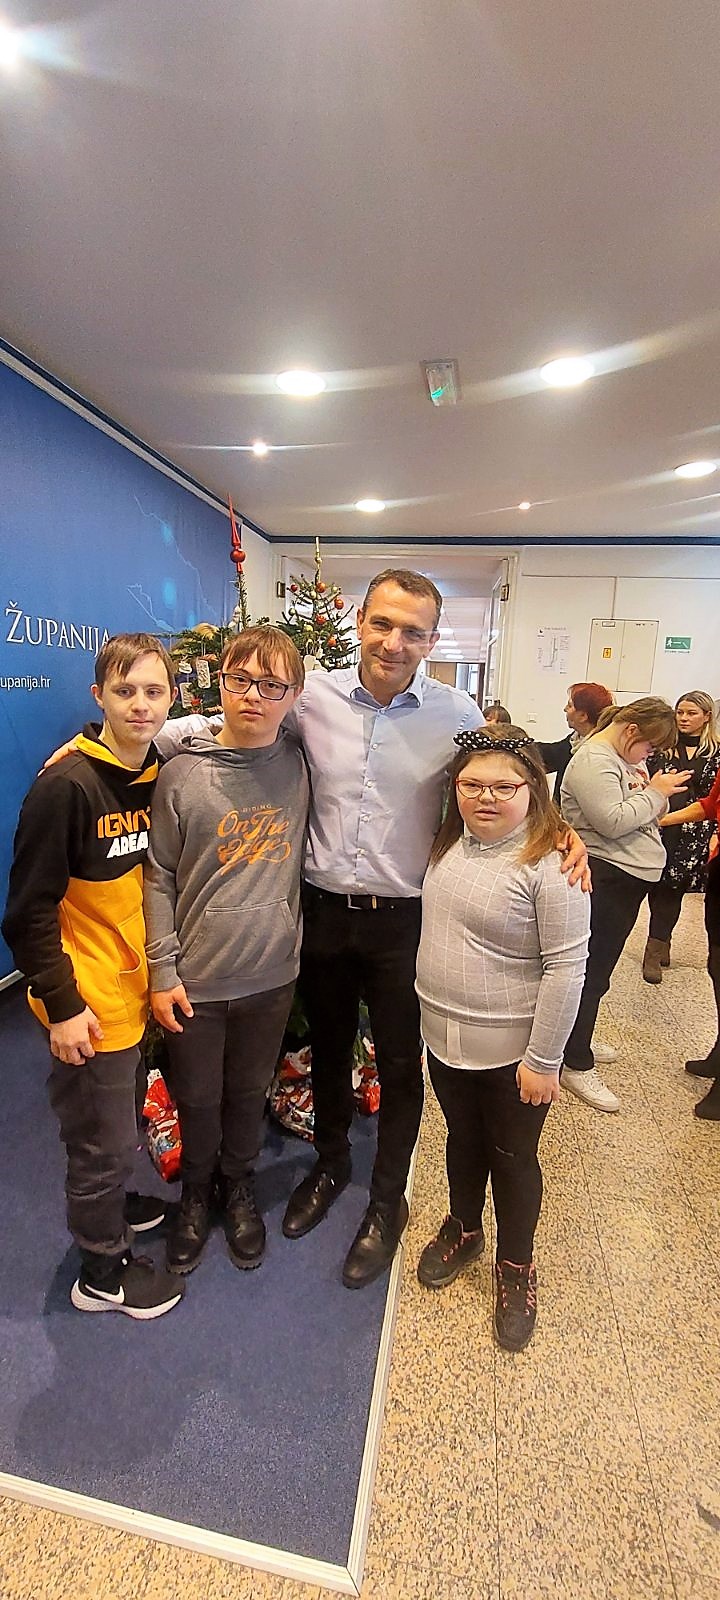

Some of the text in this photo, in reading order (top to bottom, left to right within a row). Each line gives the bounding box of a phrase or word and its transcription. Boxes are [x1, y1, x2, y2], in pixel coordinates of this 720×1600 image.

[217, 807, 289, 840] On The
[106, 830, 149, 859] AREA
